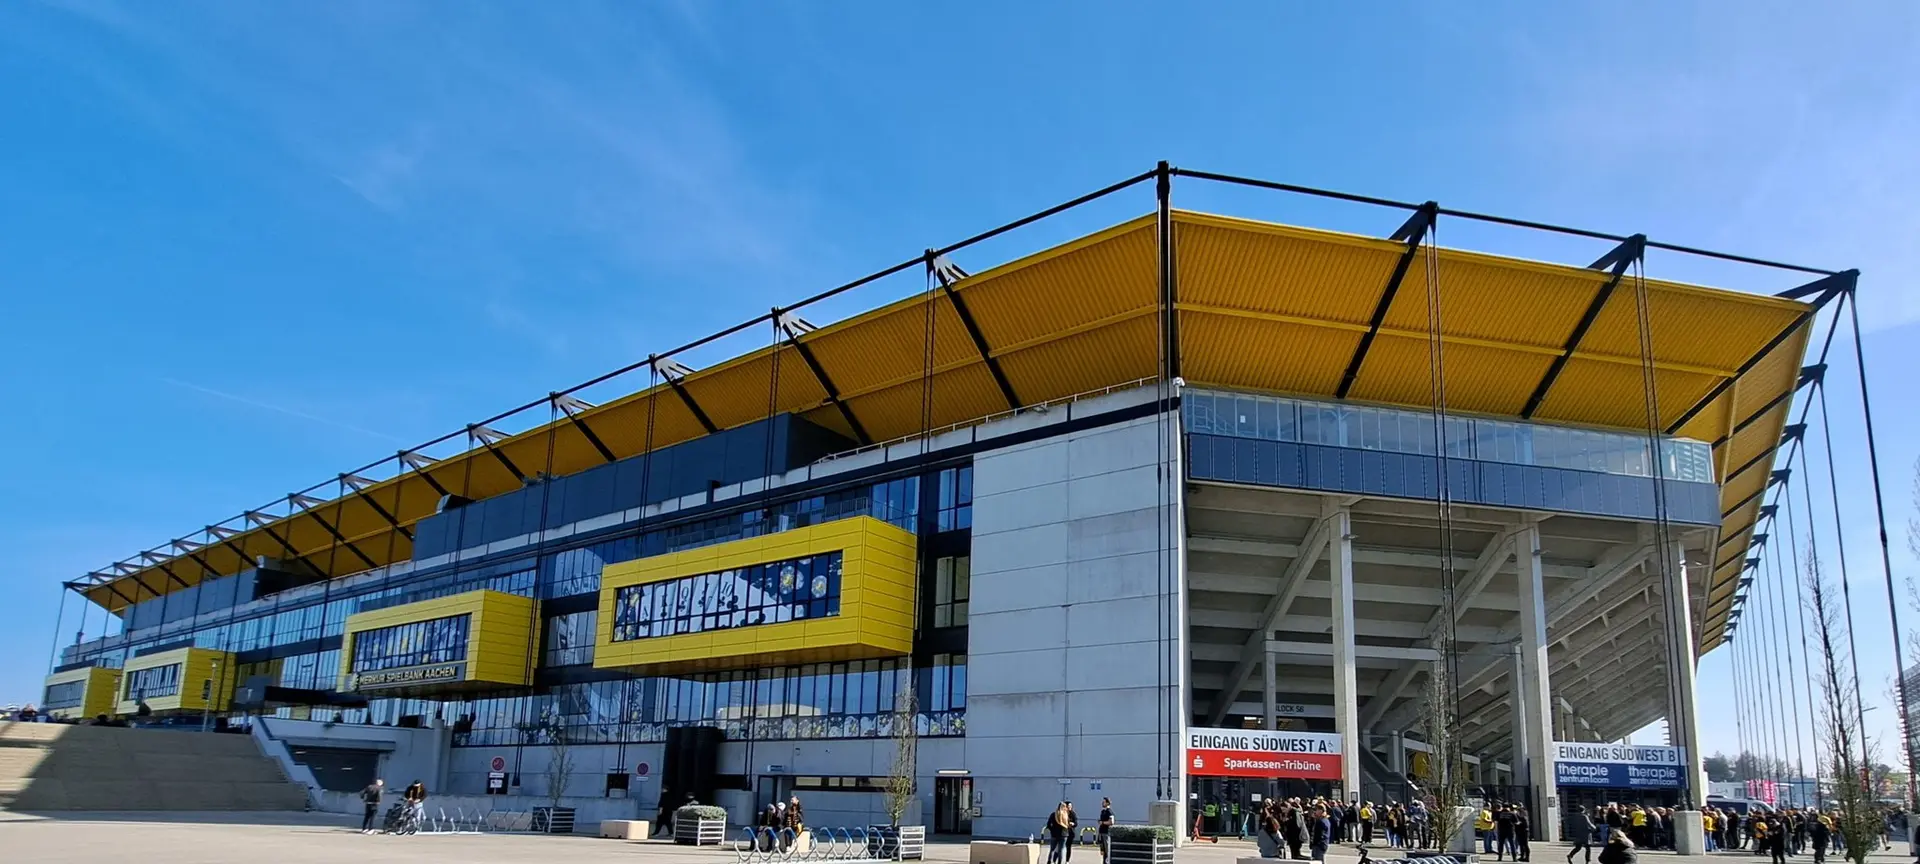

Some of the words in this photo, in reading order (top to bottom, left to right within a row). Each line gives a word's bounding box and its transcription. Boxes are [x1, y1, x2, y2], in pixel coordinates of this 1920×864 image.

[359, 673, 385, 685] MERKUR
[386, 669, 424, 681] SPIELBANK
[425, 666, 456, 678] AACHEN
[1276, 705, 1295, 713] LOCK
[1191, 734, 1249, 750] EINGANG
[1252, 734, 1315, 752] SÜDWEST
[1319, 740, 1327, 753] A
[1559, 745, 1609, 760] EINGANG
[1612, 745, 1665, 762] SÜDWEST
[1668, 750, 1676, 762] B
[1223, 757, 1322, 771] Sparkassen-Tribüne
[1557, 763, 1609, 779] therapie
[1627, 765, 1677, 780] therapie
